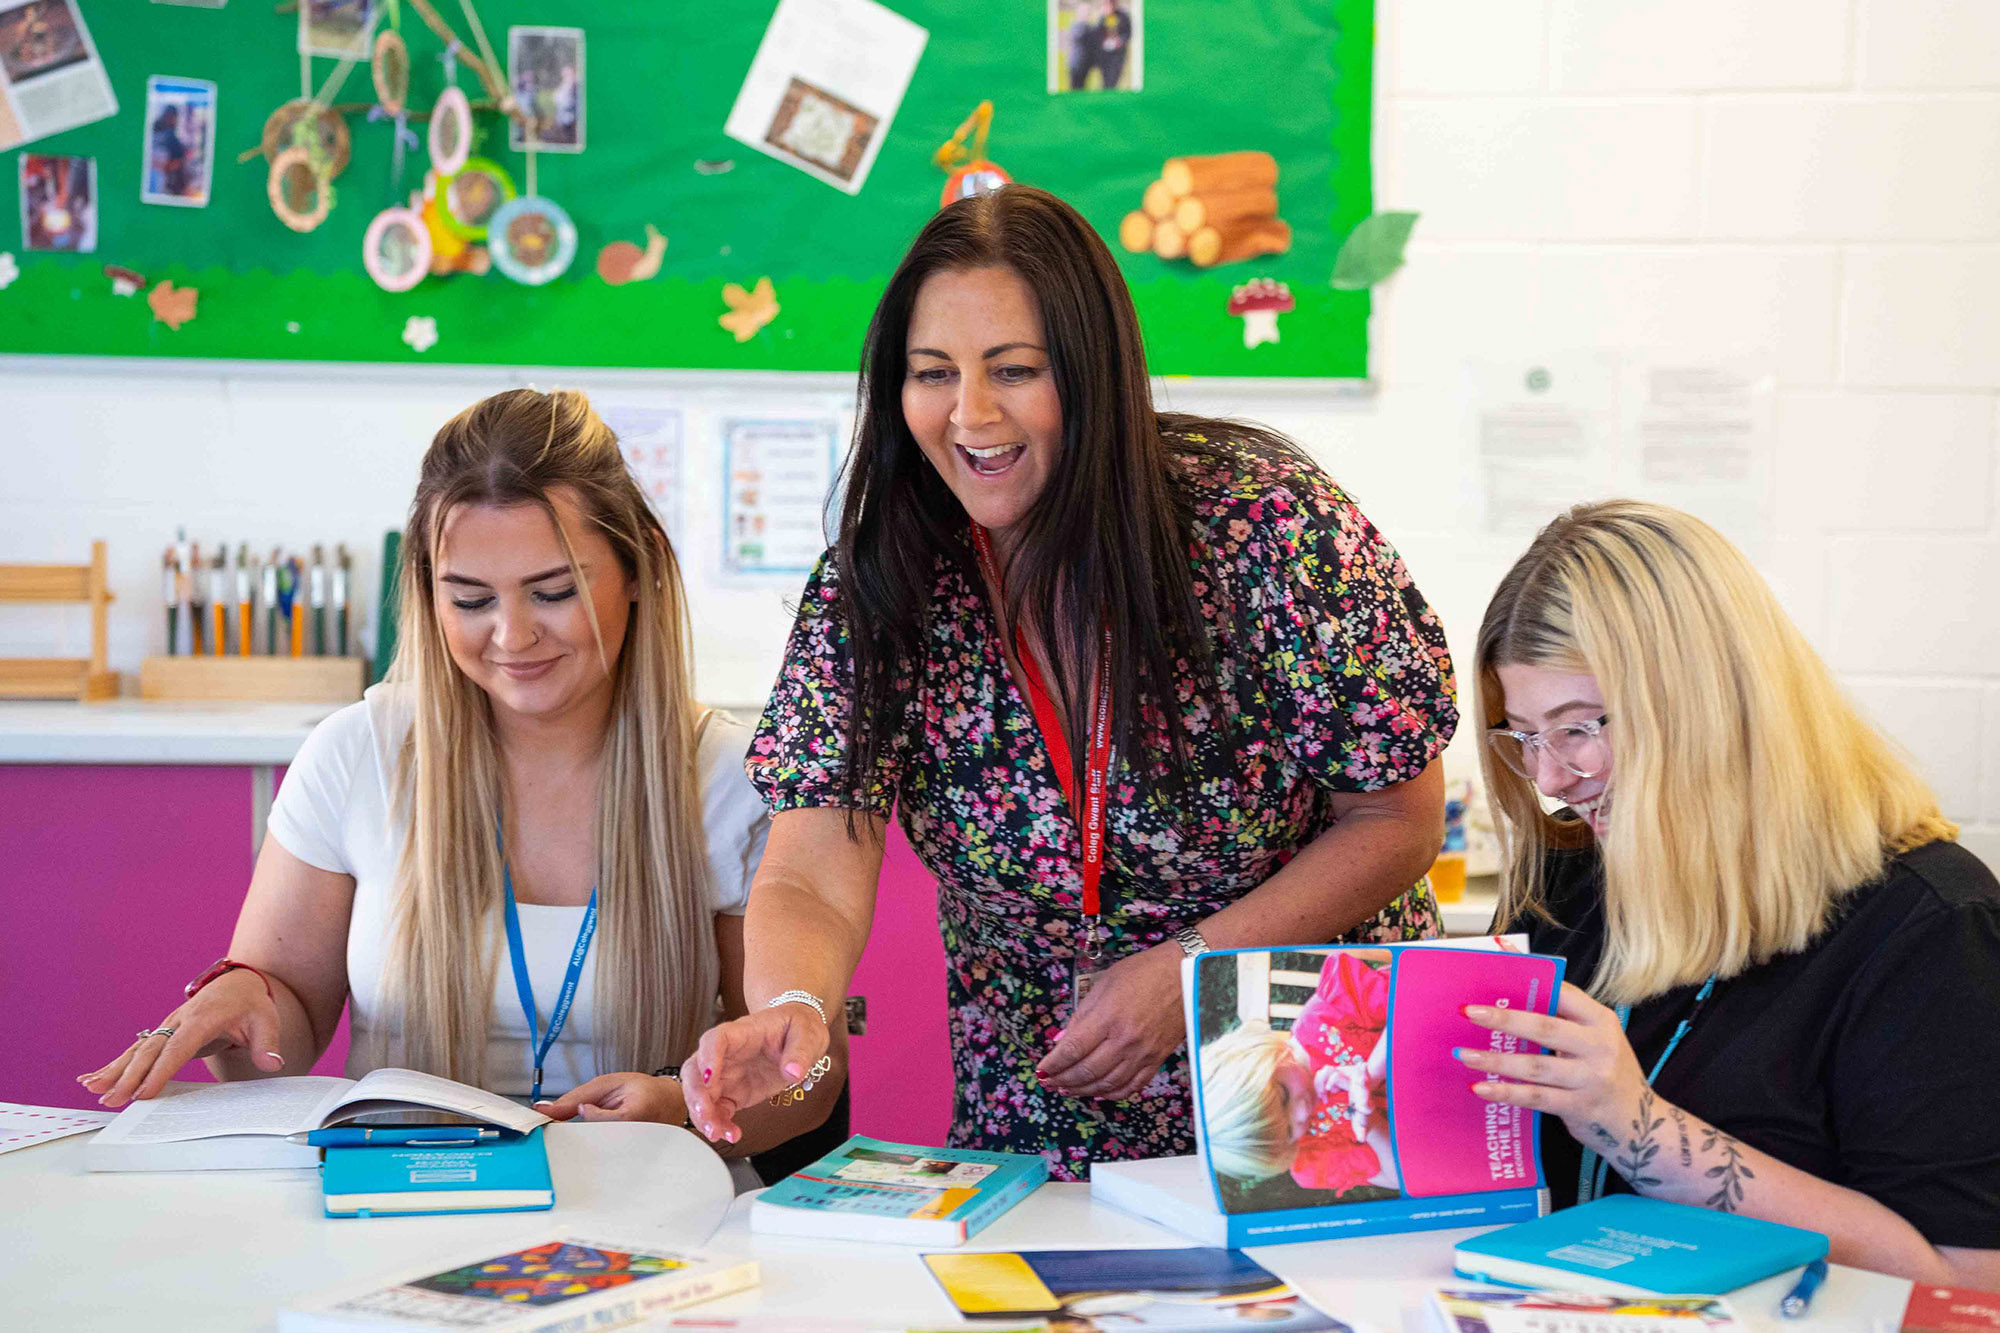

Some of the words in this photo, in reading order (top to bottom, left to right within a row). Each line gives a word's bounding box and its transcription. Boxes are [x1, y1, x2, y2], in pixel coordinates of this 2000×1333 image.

[1090, 768, 1102, 794] Staff
[1088, 796, 1101, 831] Gwent
[1087, 833, 1101, 864] Coleg
[1485, 1102, 1502, 1181] TEACHING
[1500, 1129, 1512, 1160] THE
[1503, 1162, 1516, 1179] IN
[1514, 1139, 1525, 1178] SECOND
